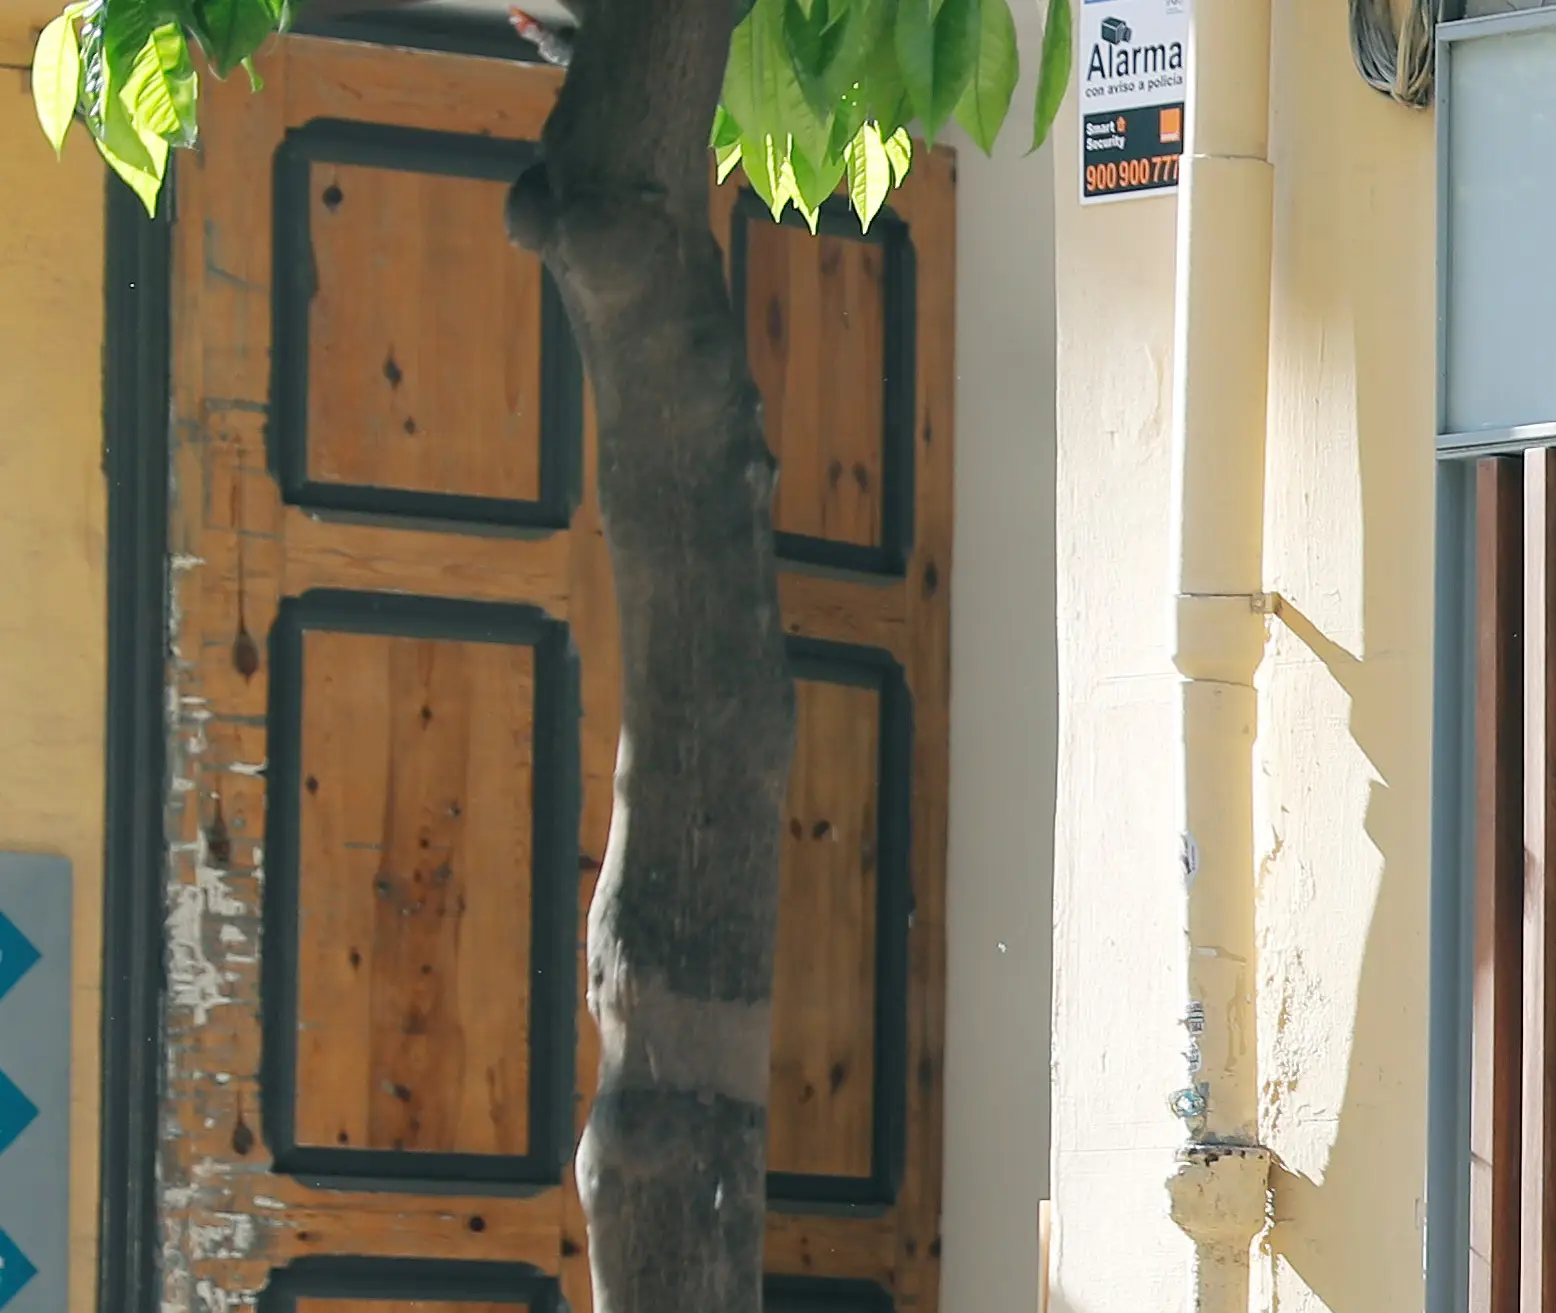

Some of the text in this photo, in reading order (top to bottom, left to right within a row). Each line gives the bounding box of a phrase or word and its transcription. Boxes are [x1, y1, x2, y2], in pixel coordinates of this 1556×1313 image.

[1087, 41, 1182, 81] Alarma
[1085, 86, 1105, 98] con
[1108, 81, 1136, 95] aviso
[1138, 80, 1145, 90] a
[1086, 121, 1116, 136] Smart
[1086, 134, 1125, 150] Security
[1086, 163, 1117, 191] 900
[1119, 158, 1149, 187] 900
